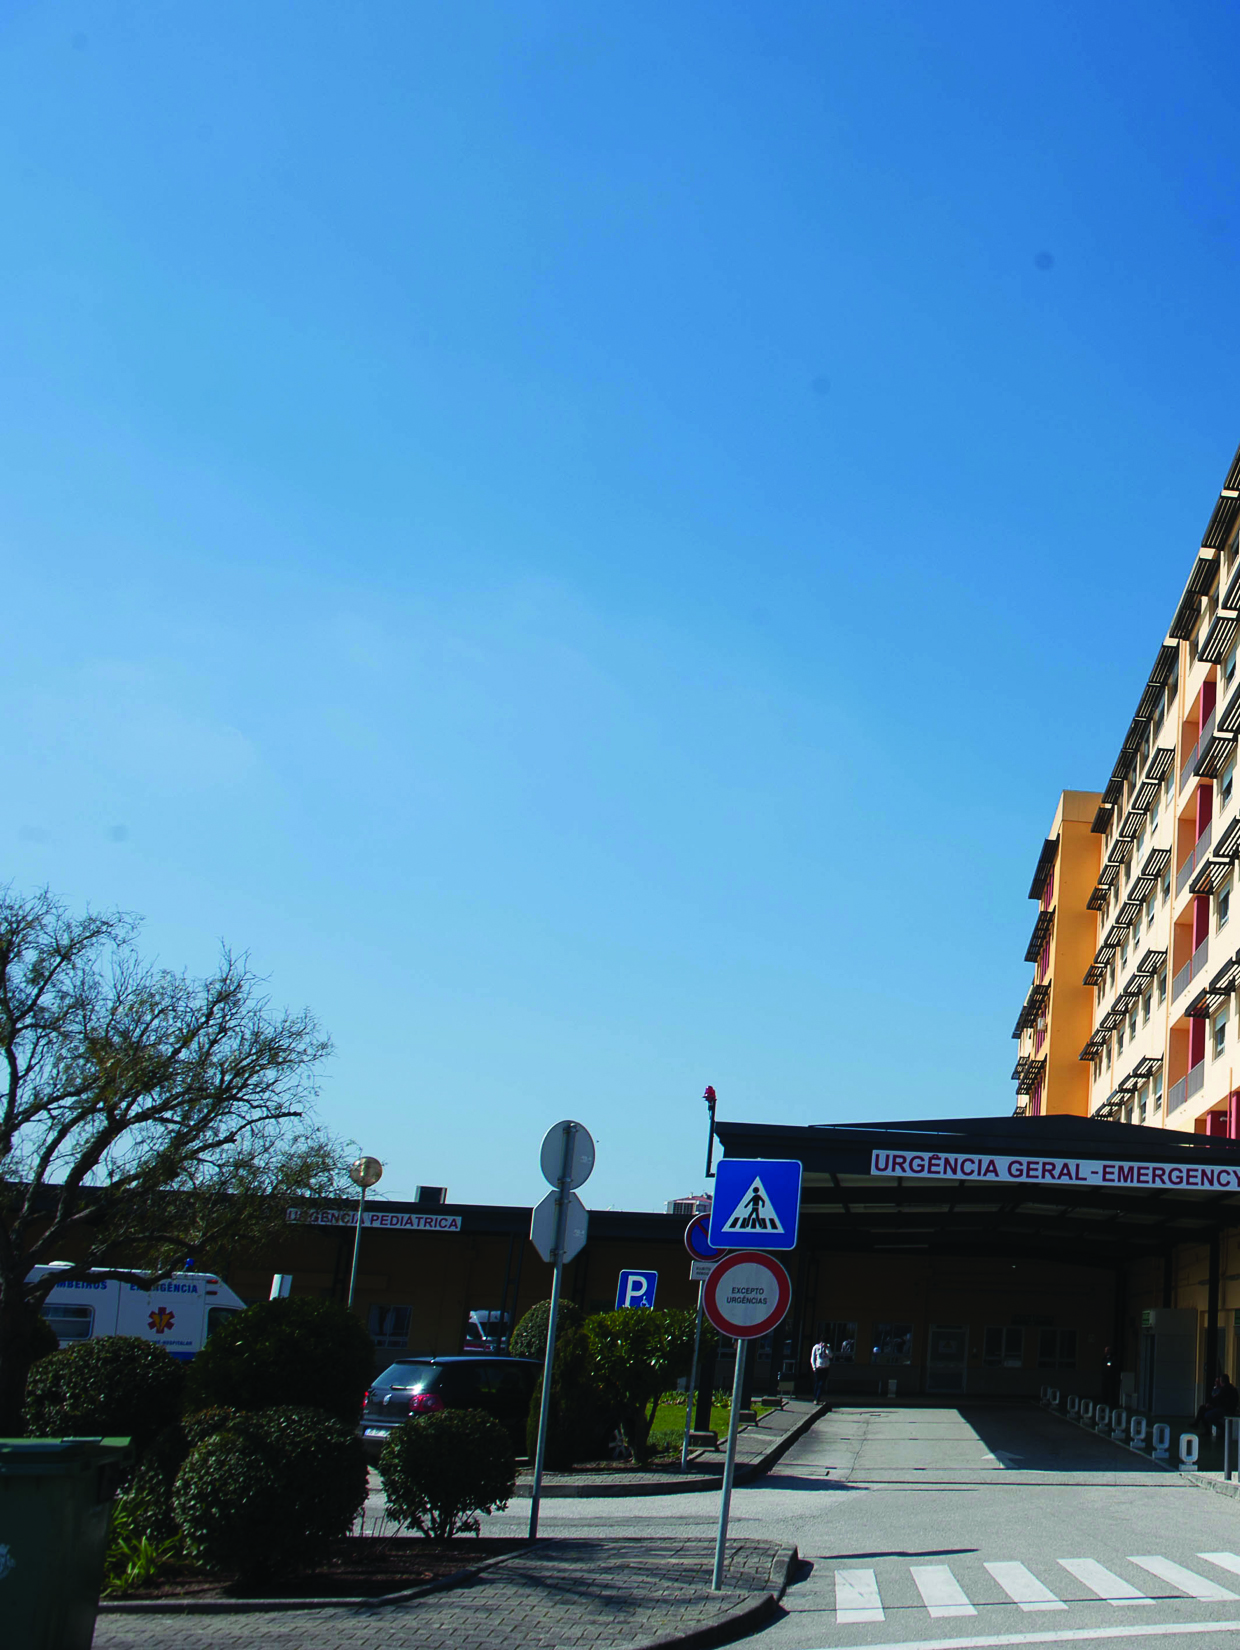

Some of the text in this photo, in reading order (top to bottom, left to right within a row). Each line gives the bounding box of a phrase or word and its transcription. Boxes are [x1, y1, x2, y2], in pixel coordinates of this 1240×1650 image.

[873, 1153, 1000, 1178] URGÊNCIA
[1007, 1159, 1088, 1182] GERAL
[369, 1213, 460, 1230] PEDIÁTRICA
[624, 1275, 648, 1308] P
[731, 1286, 765, 1295] EXCEPTO
[726, 1295, 768, 1305] URGÊNCIAS
